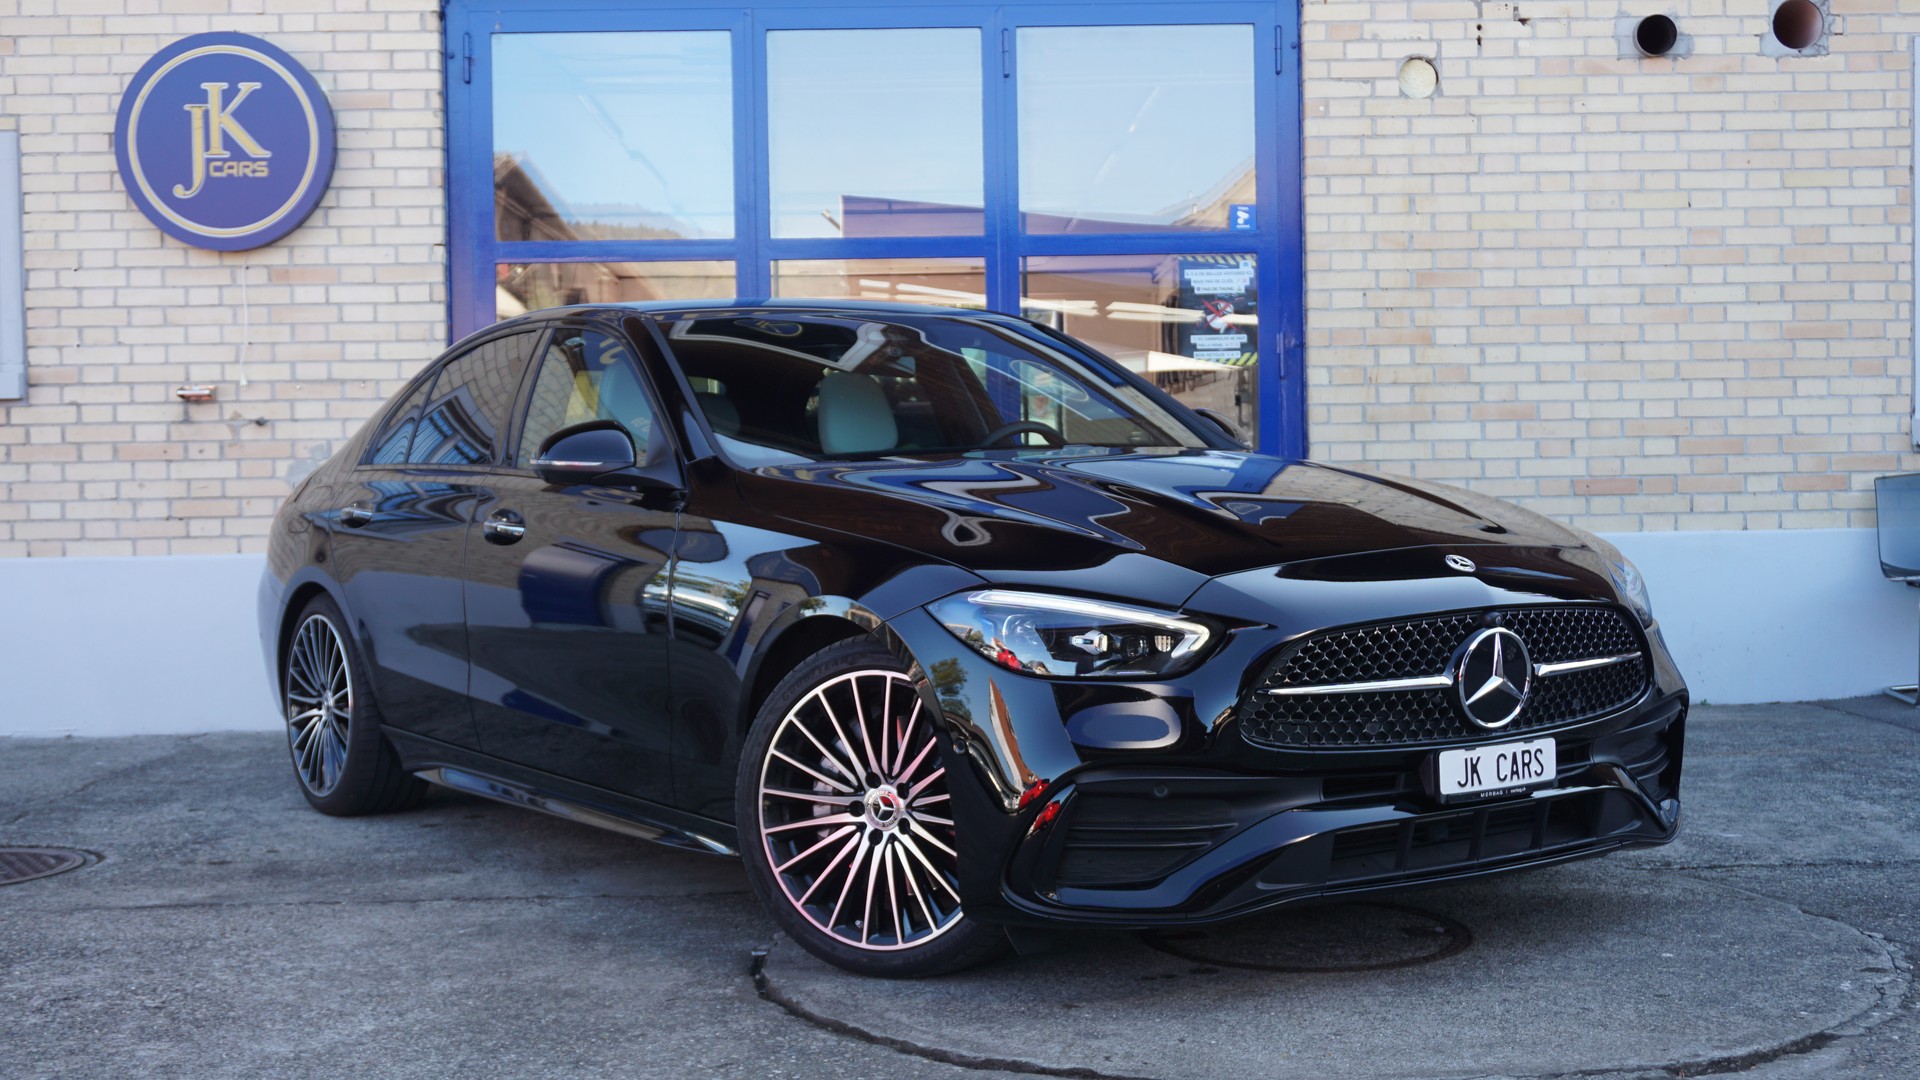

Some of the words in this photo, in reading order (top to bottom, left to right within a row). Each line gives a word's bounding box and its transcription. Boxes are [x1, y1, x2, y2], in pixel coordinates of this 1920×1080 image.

[172, 82, 272, 198] JK
[209, 161, 269, 177] CARS
[1457, 756, 1482, 788] JK
[1496, 747, 1544, 782] CARS
